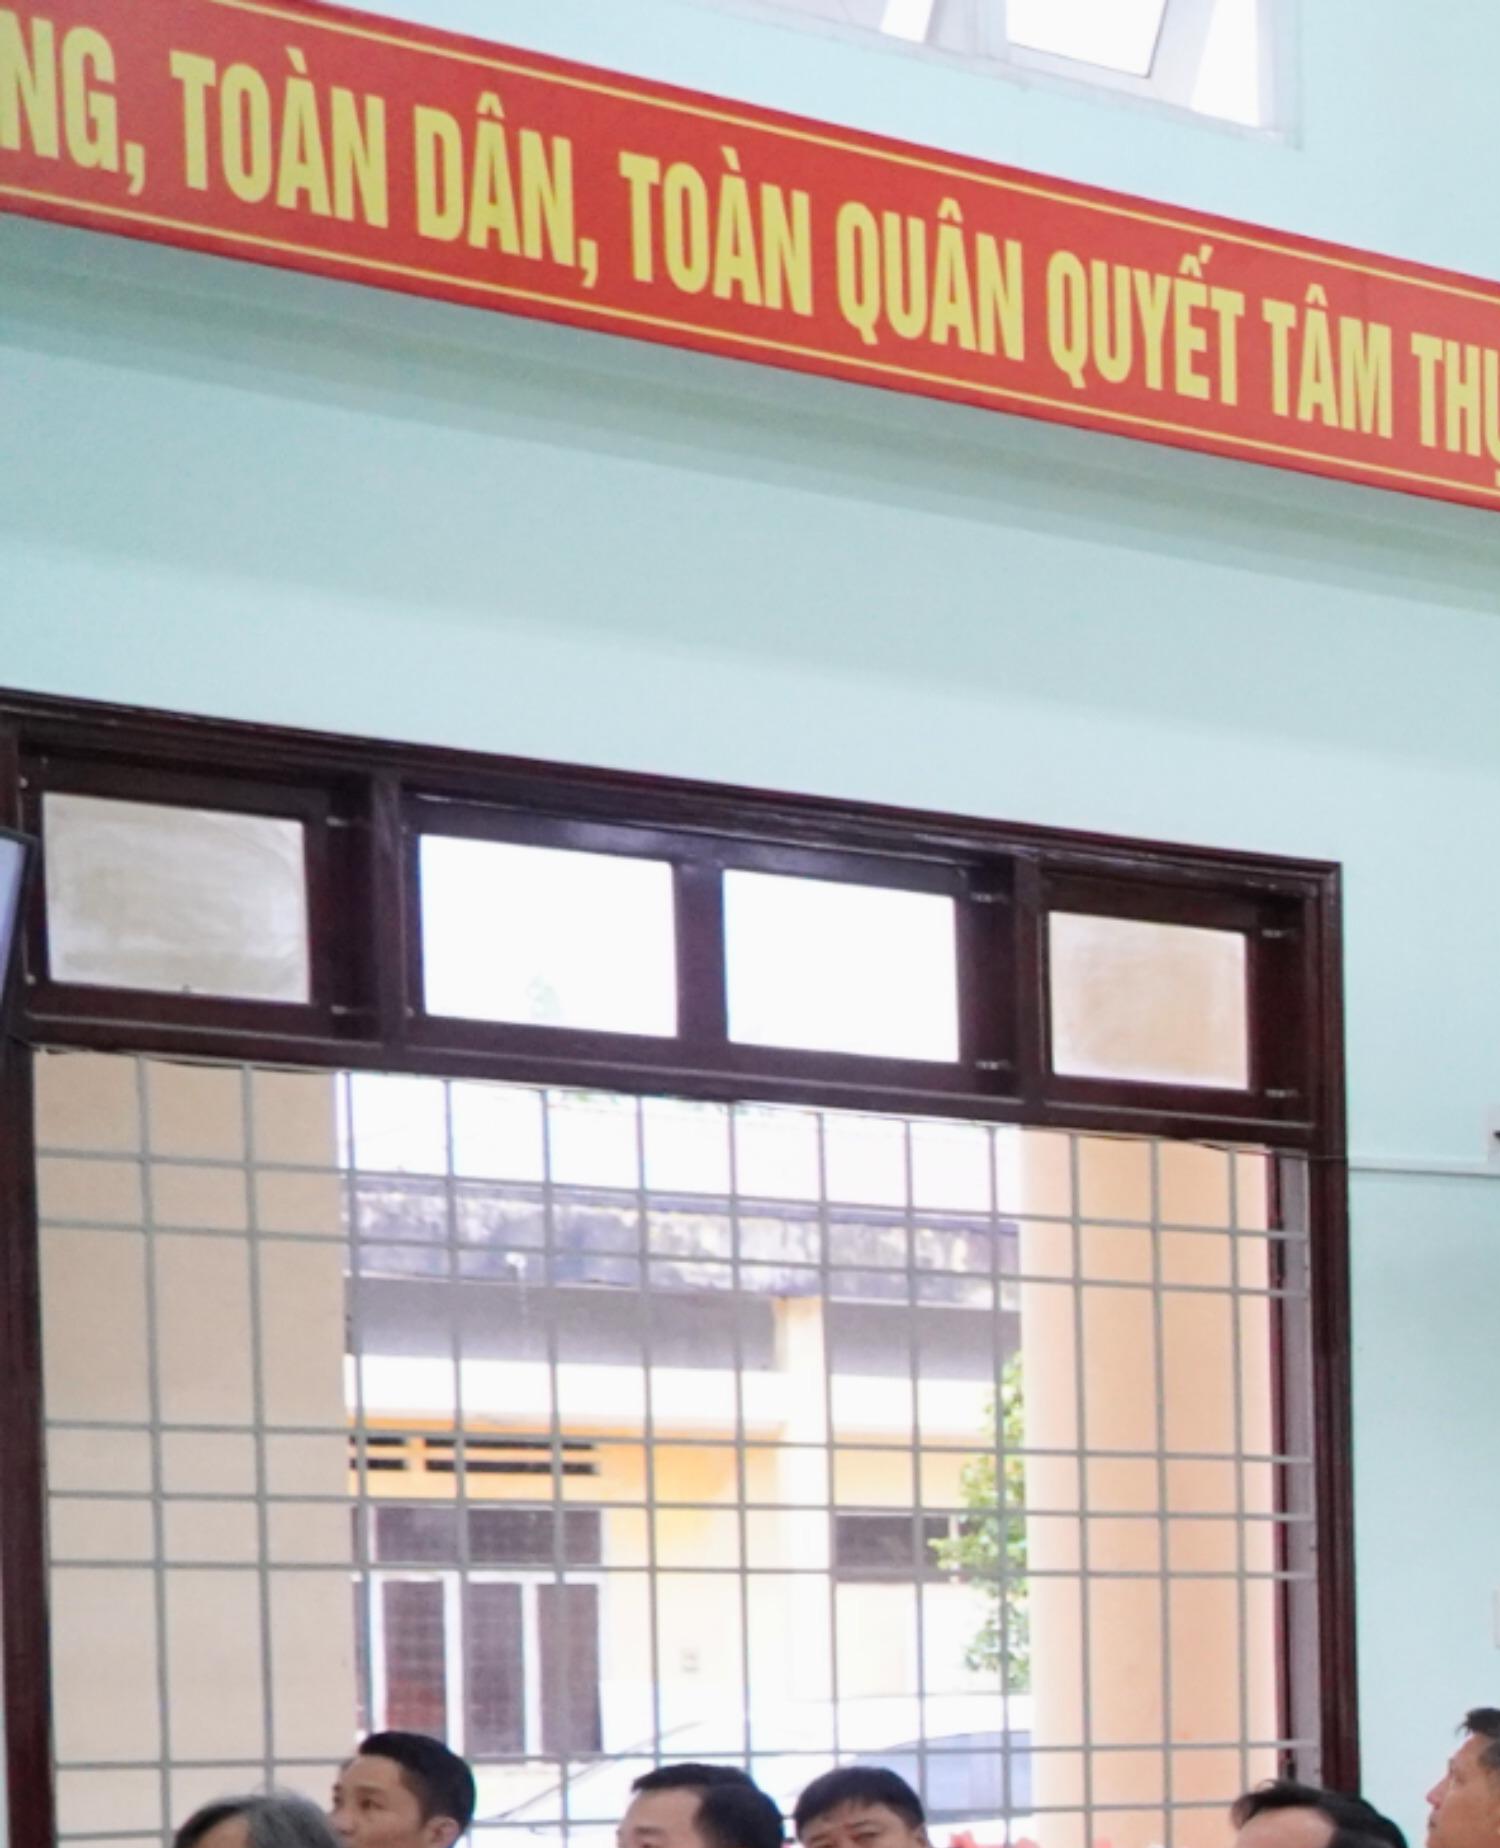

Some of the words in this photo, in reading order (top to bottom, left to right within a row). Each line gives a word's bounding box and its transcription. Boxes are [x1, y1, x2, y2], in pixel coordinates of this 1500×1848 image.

[169, 46, 388, 229] TOÀN
[413, 91, 599, 288] DÂN,
[619, 146, 814, 316] TOÀN
[836, 197, 1026, 362] QUÂN
[1046, 245, 1246, 406] QUYẾT
[1263, 283, 1393, 439] TÂM
